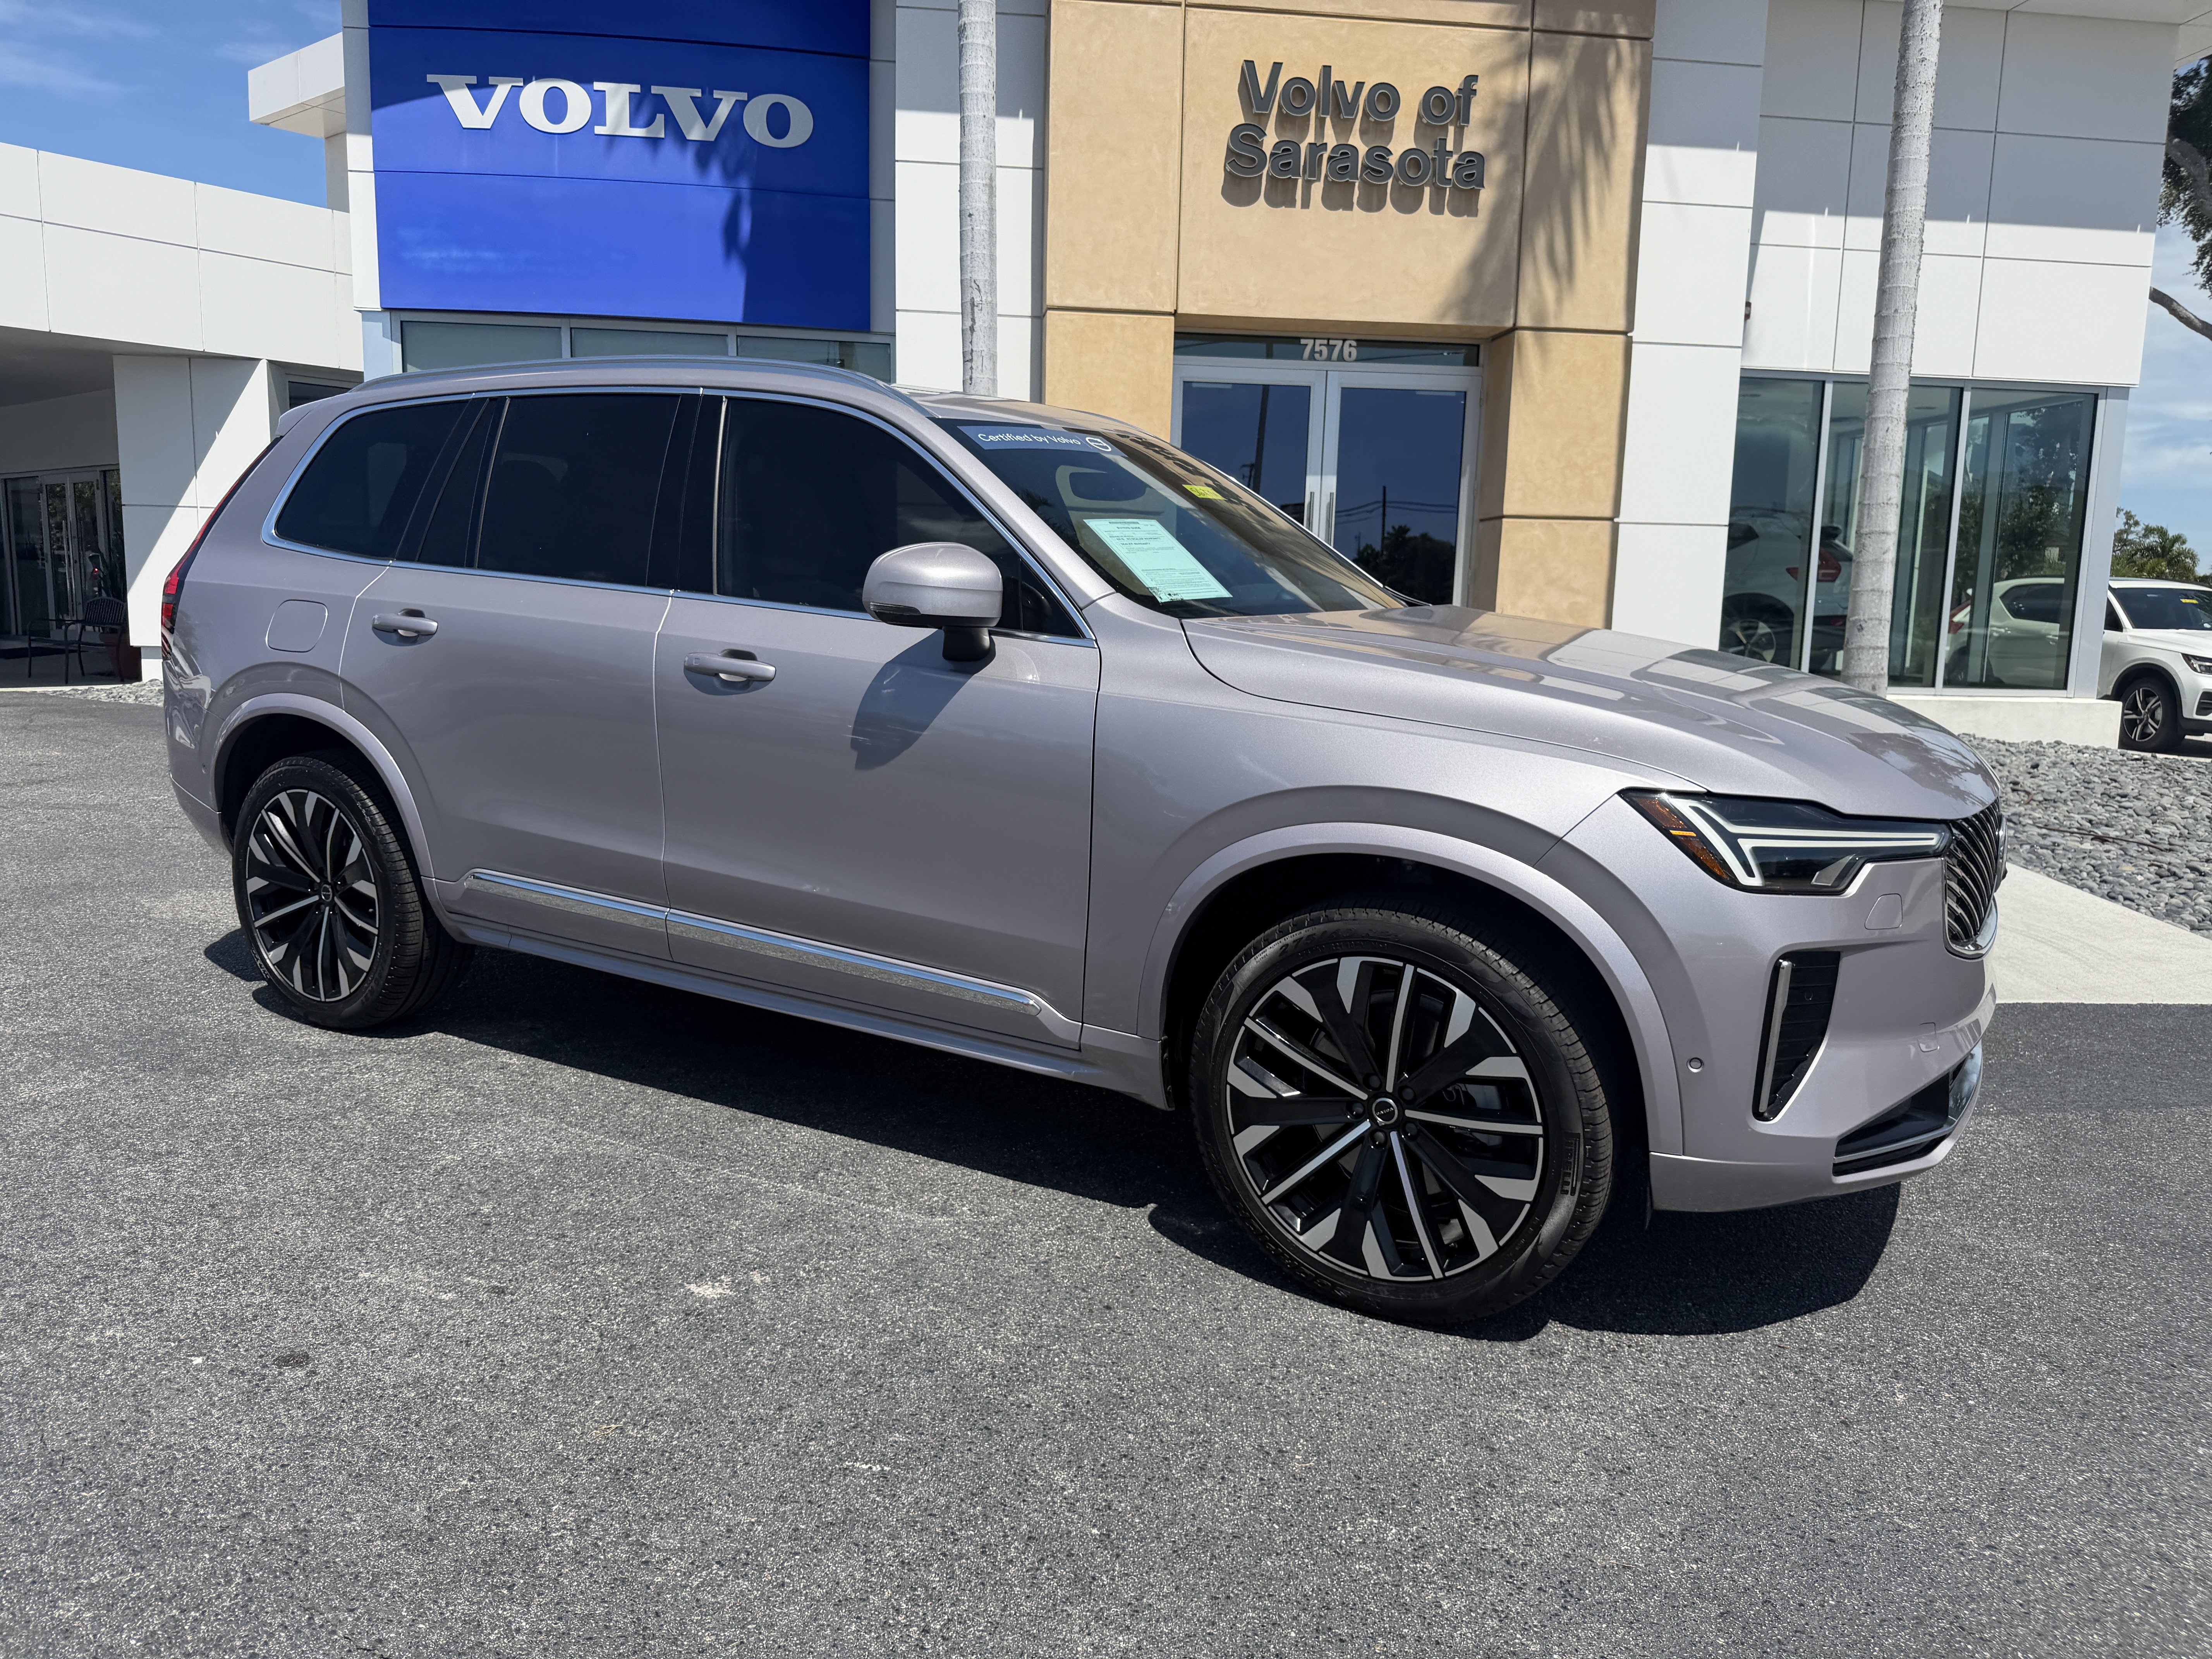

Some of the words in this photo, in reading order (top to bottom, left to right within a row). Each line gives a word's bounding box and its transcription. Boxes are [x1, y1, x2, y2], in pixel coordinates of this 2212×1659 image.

[427, 74, 814, 148] VOLVO
[1239, 60, 1401, 122] Volvo
[1418, 74, 1479, 126] of
[1225, 123, 1486, 189] Sarasota
[1300, 339, 1357, 362] 7576
[978, 433, 1032, 442] Certified
[1032, 434, 1049, 444] by
[1047, 435, 1081, 445] Volvo
